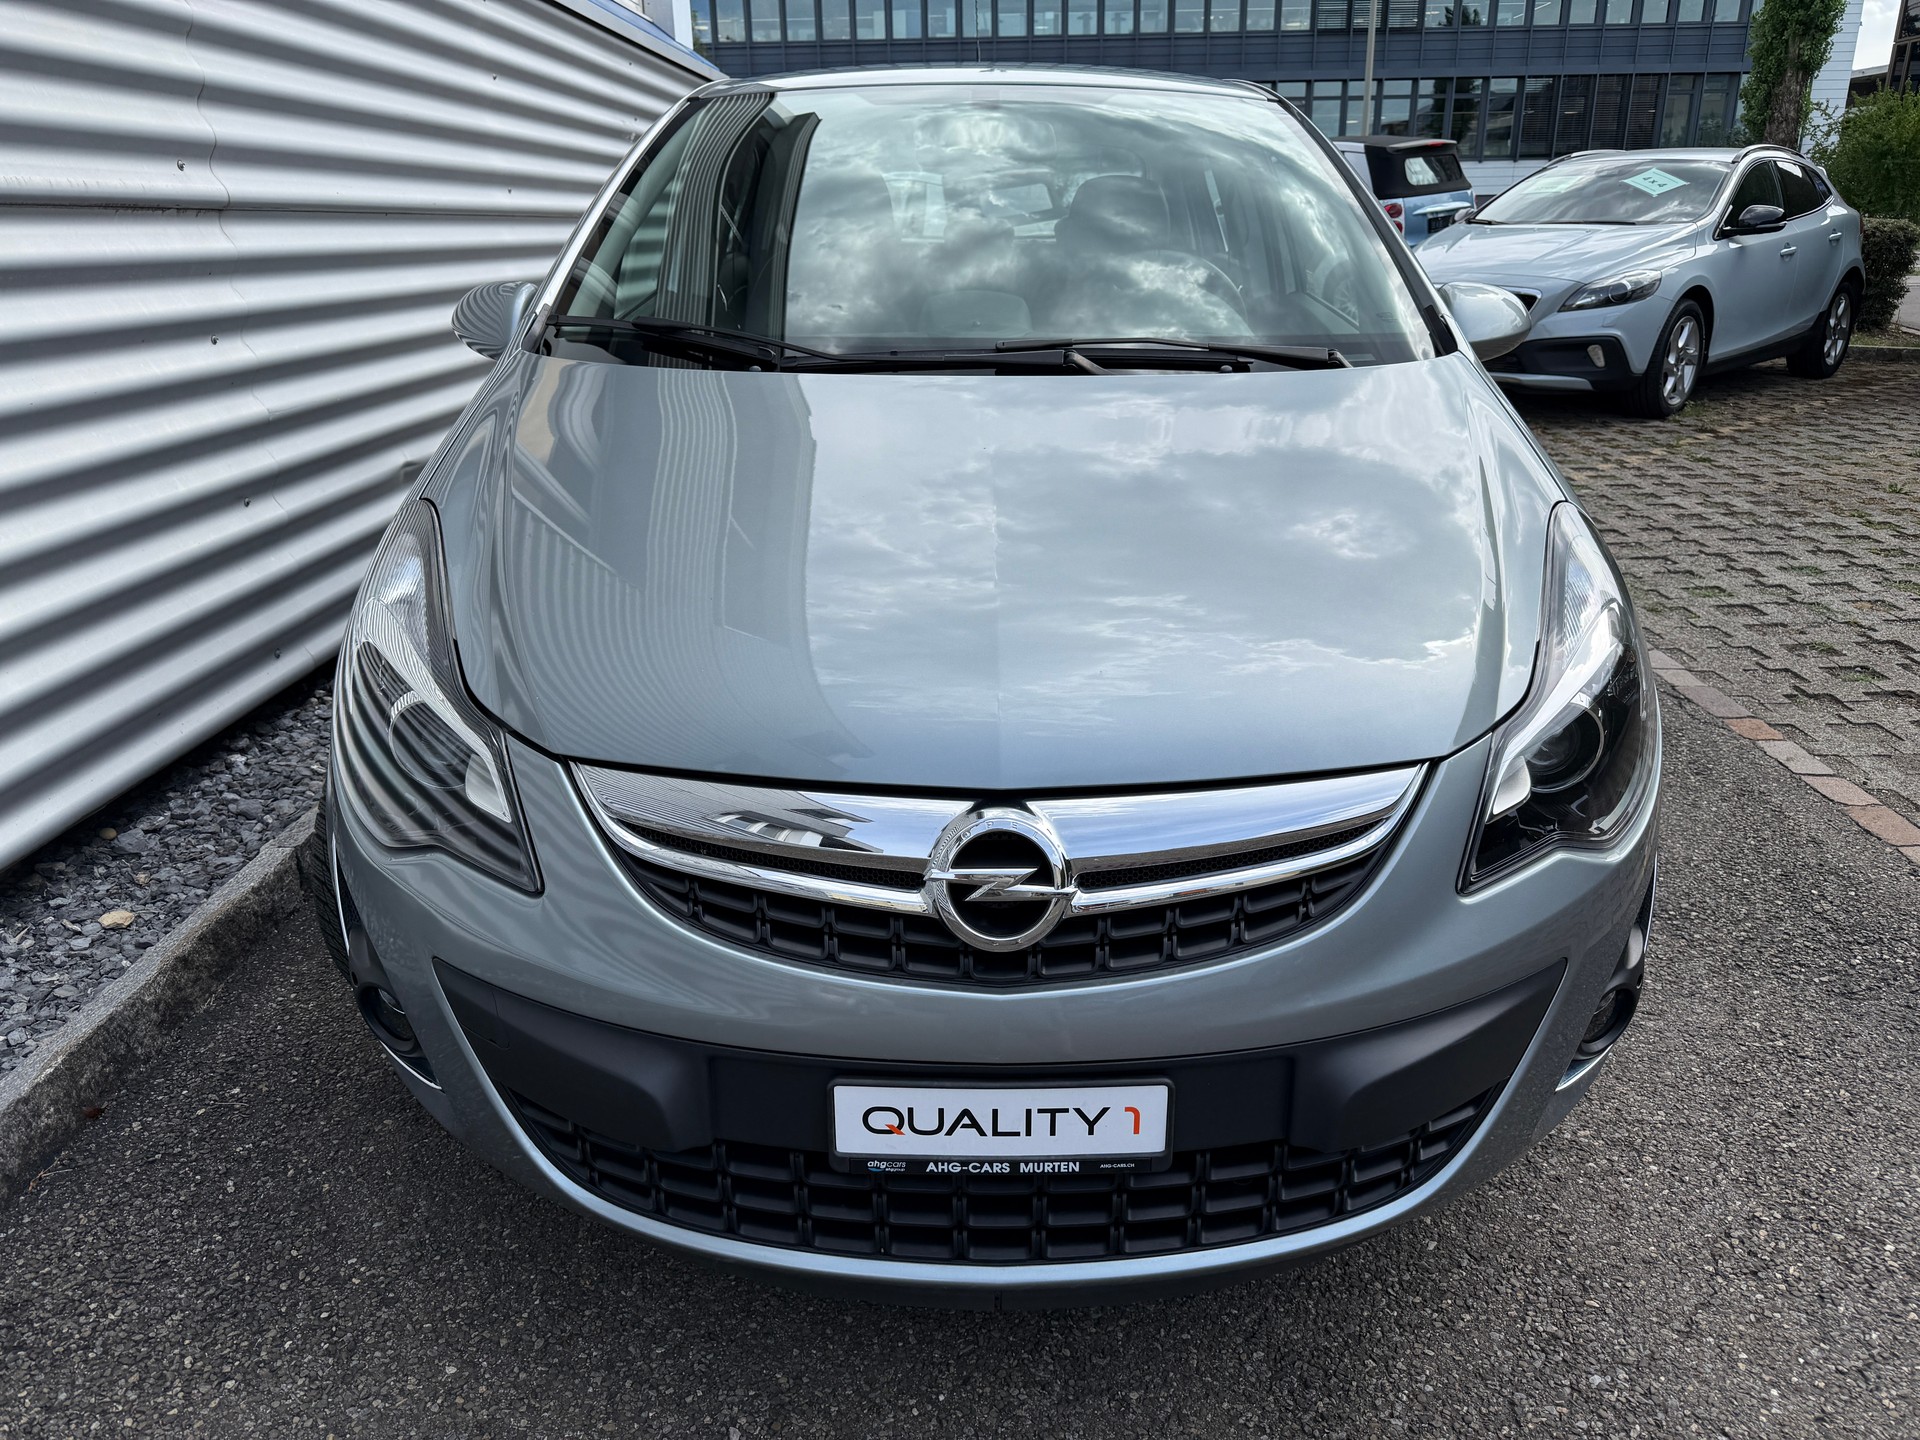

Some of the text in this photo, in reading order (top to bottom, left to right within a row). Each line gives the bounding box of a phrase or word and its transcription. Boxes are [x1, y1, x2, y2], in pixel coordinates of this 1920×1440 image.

[960, 821, 1041, 841] OPEL
[862, 1106, 1140, 1136] QUALITY 1
[867, 1160, 906, 1169] ahgcars
[926, 1161, 1080, 1173] AHG-CARS MURTEN
